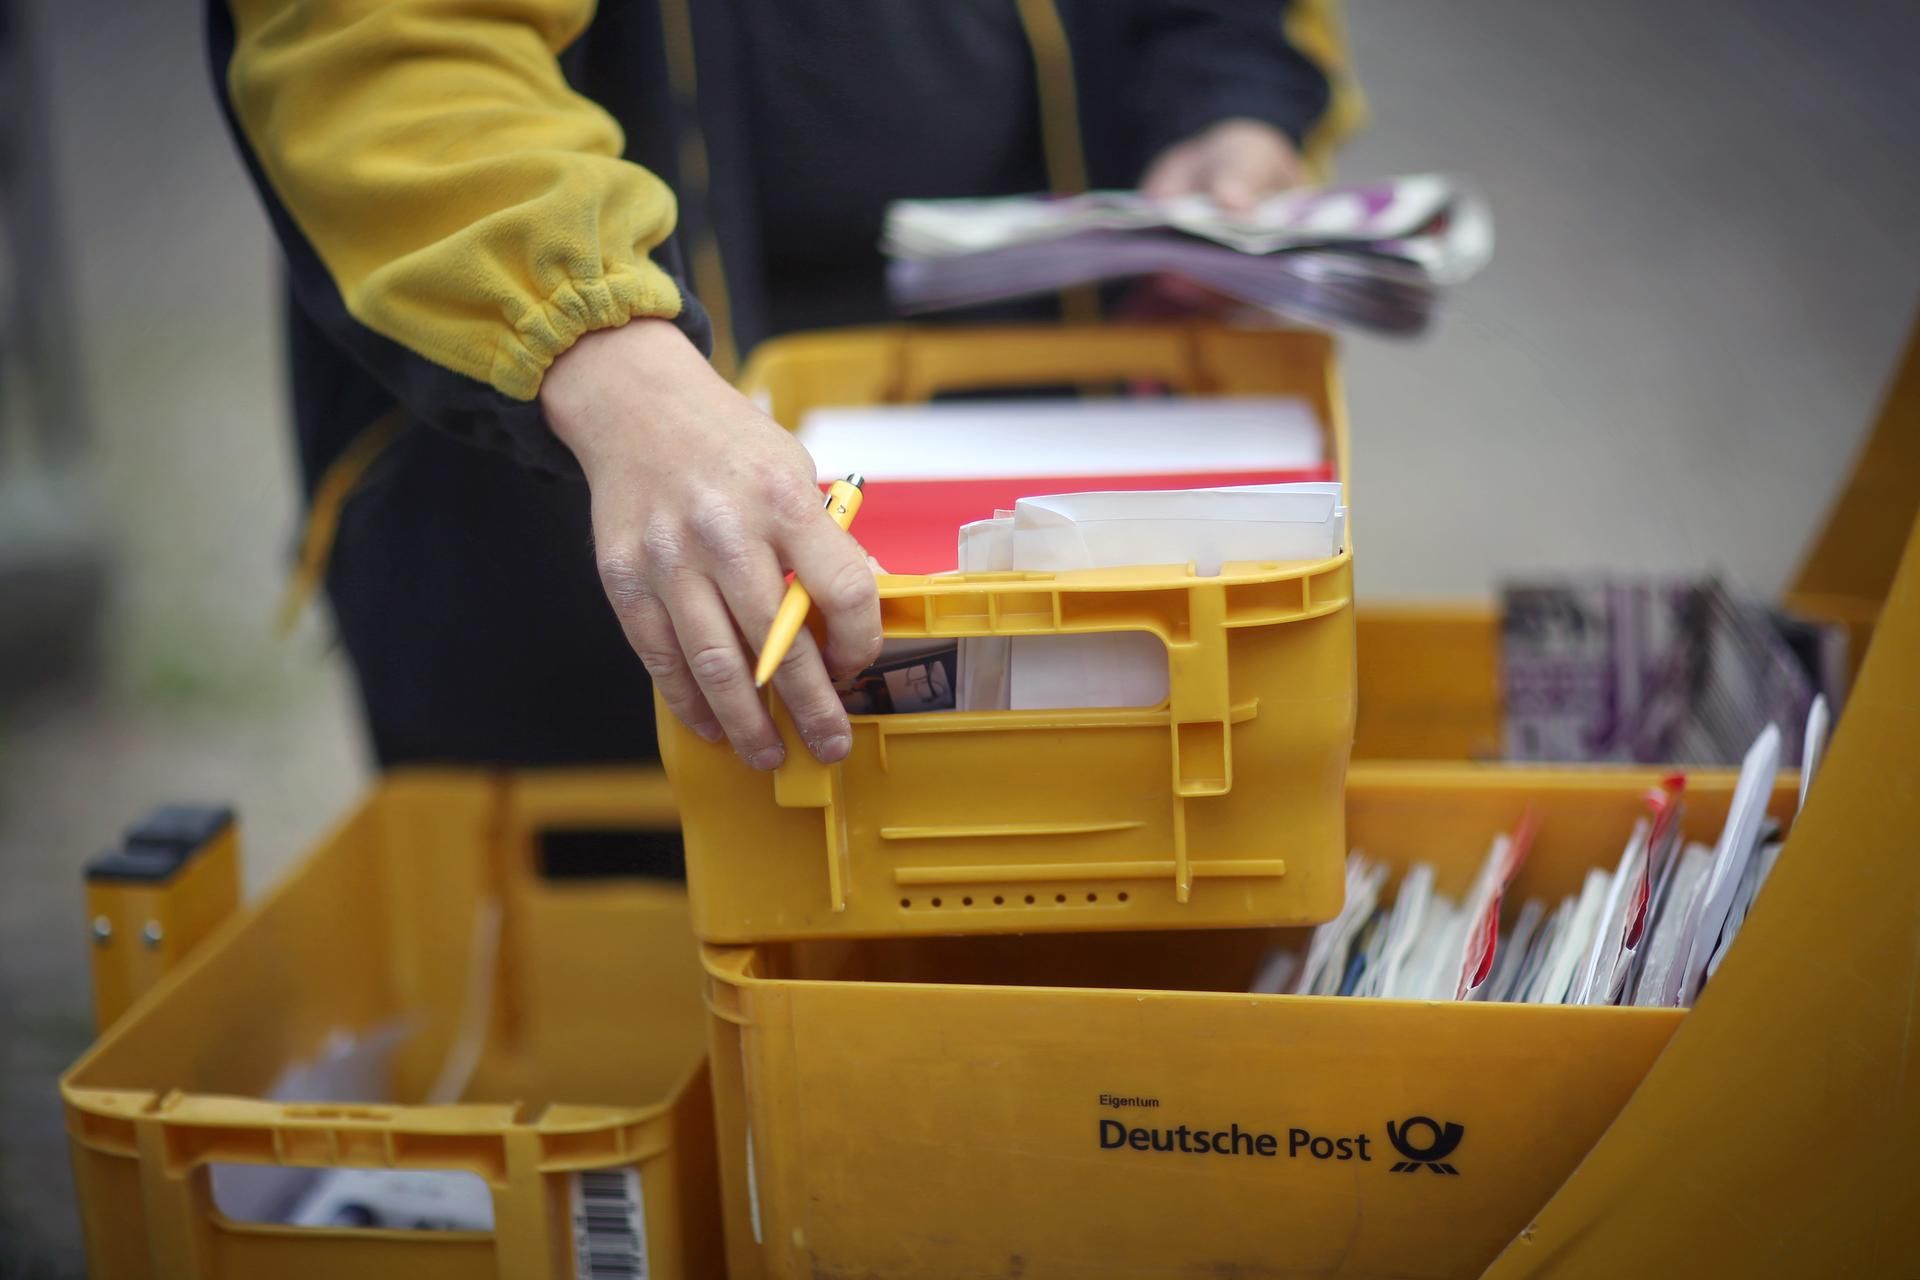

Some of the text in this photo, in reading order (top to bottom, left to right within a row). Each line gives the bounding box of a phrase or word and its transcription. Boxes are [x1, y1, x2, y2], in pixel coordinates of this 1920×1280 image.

[1099, 1094, 1160, 1109] Eigentum
[1099, 1118, 1372, 1162] Deutsche Post
